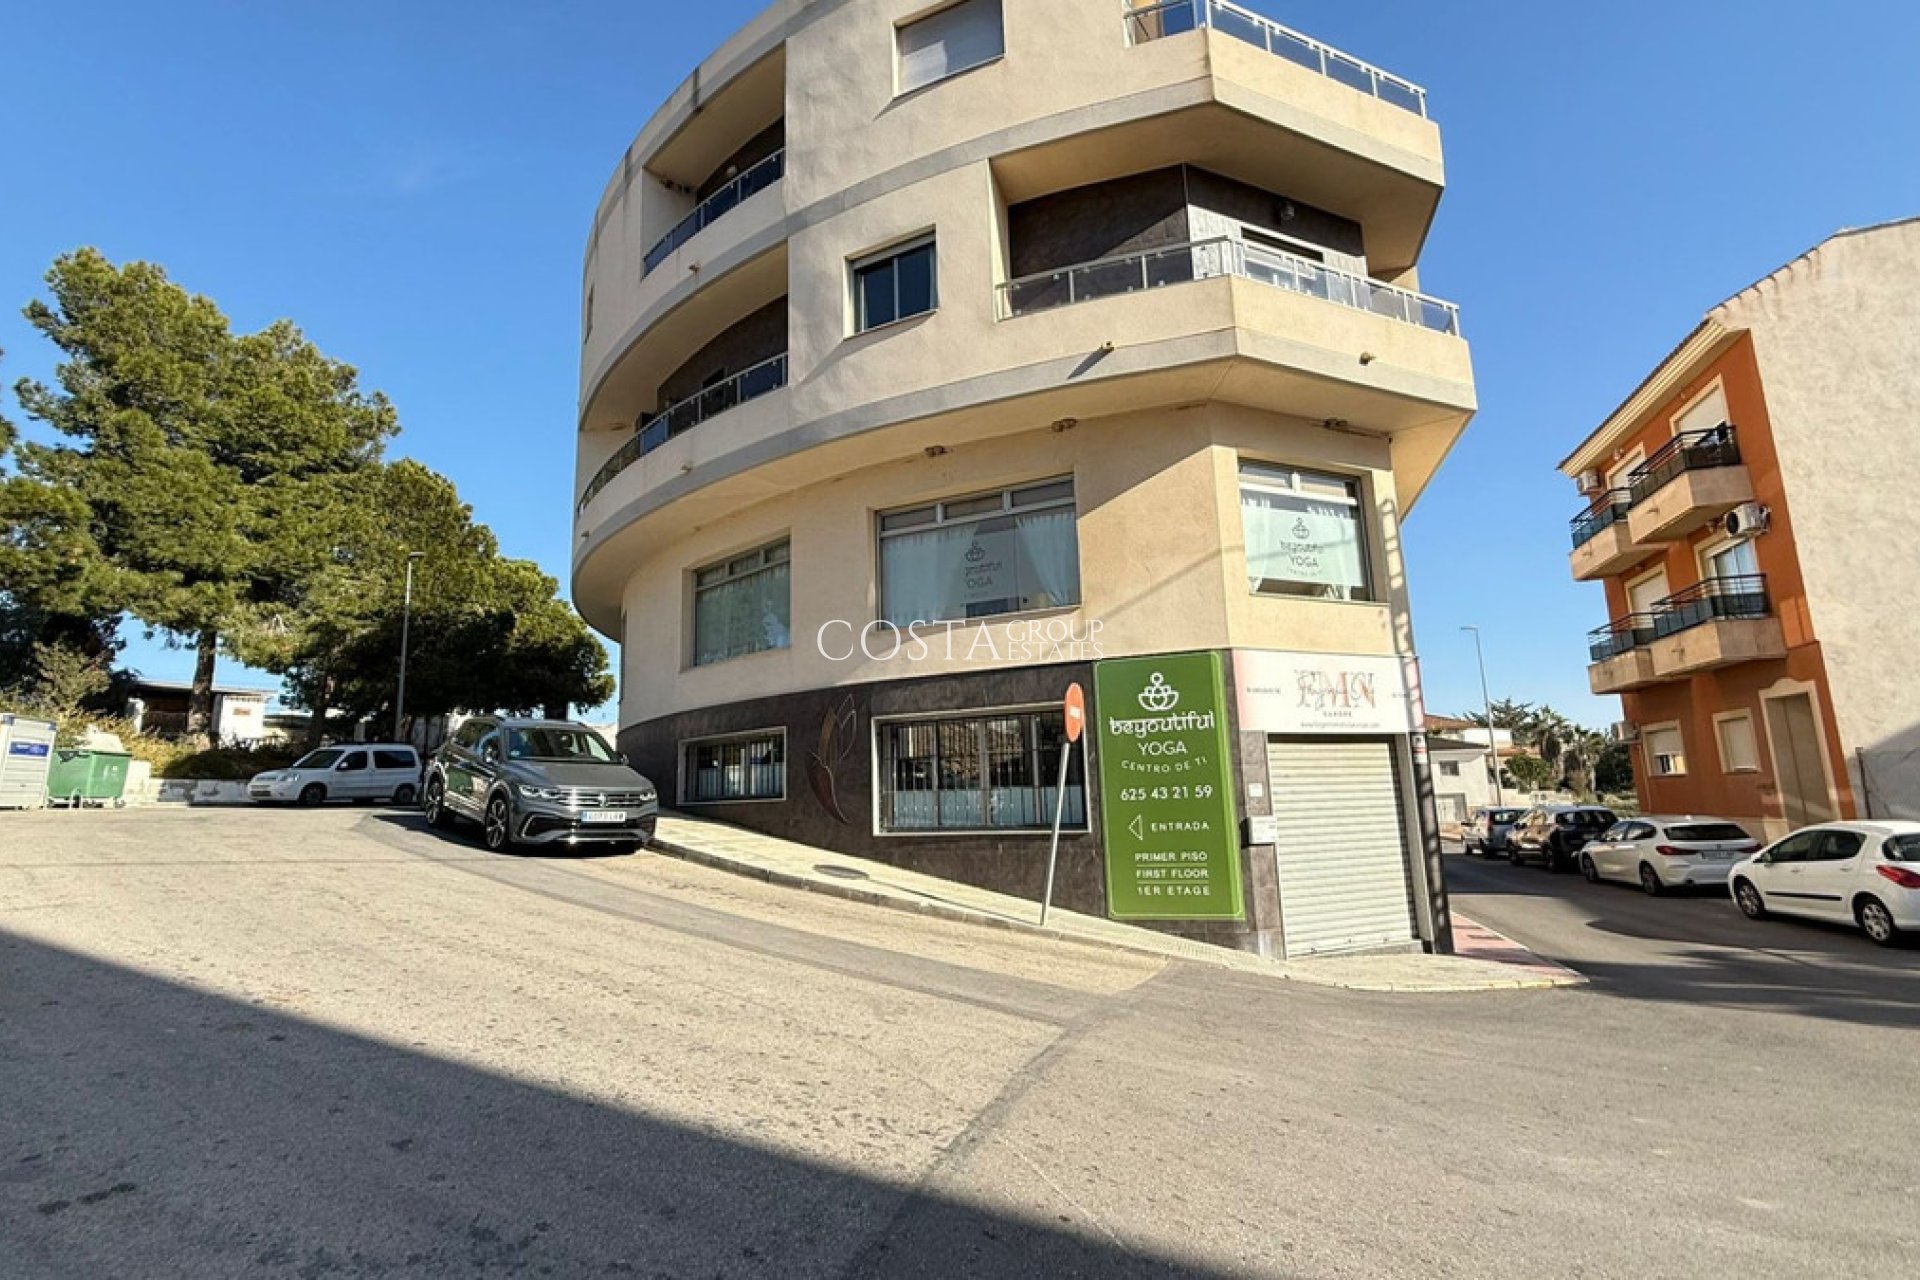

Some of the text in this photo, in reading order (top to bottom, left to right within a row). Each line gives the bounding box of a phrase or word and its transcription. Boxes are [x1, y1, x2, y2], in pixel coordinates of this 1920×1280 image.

[1109, 710, 1215, 739] beyoutiful
[1137, 740, 1189, 756] YOGA
[1121, 759, 1171, 773] CENTRO
[1175, 761, 1191, 772] DE
[1120, 784, 1213, 801] 625 43 21 59
[1151, 821, 1210, 832] ENTRADA
[1134, 851, 1208, 862] PRIMER PISO
[1136, 868, 1209, 878] FIRST FLOOR
[1167, 885, 1211, 896] ETAGE
